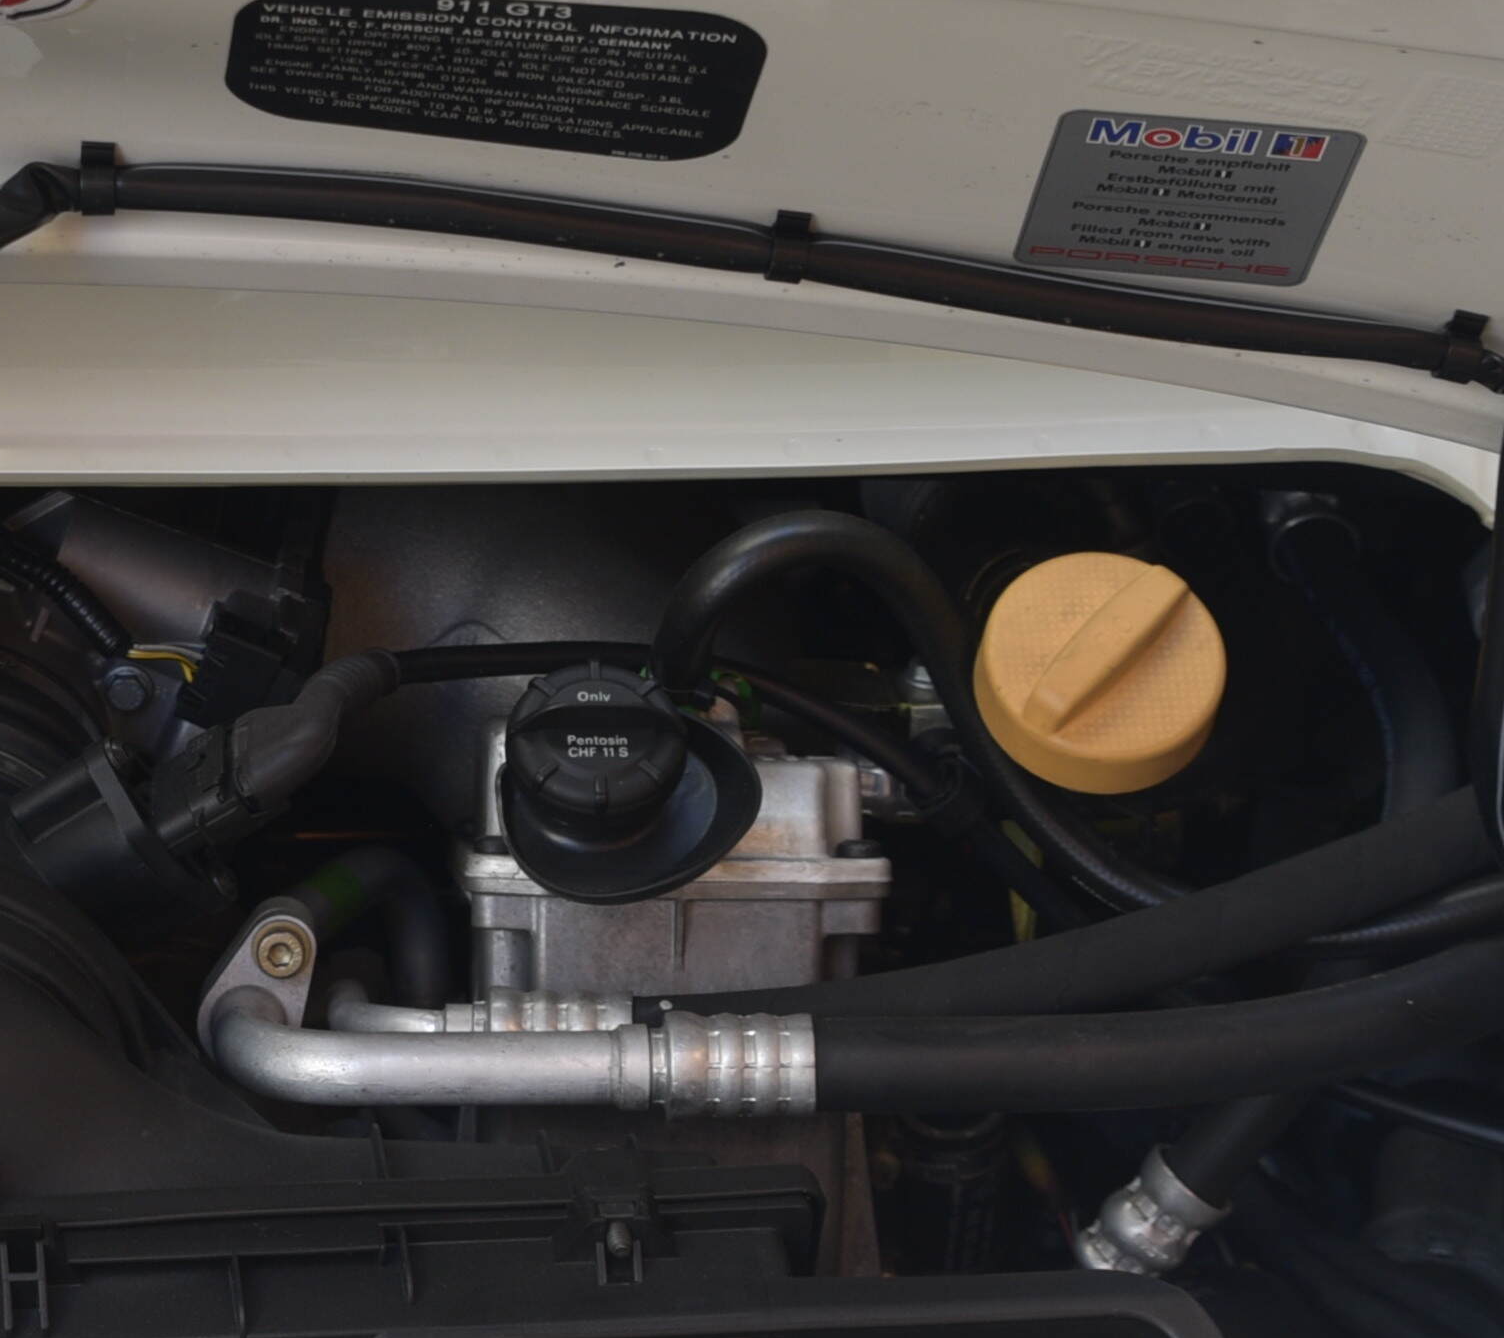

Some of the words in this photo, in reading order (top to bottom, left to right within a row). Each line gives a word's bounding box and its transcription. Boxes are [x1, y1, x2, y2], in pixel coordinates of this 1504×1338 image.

[262, 2, 352, 17] VEHICLE
[361, 8, 465, 24] EMISSION
[474, 16, 580, 32] CONTROL
[588, 23, 739, 43] INFORMATION
[503, 2, 574, 19] GT3
[259, 14, 284, 24] DR.
[291, 16, 323, 26] ING.
[460, 28, 485, 37] AG
[490, 30, 585, 44] STUTTGART
[596, 37, 673, 51] GERMANY
[278, 24, 329, 35] ENGINE
[337, 28, 355, 37] AT
[363, 30, 441, 43] OPERATING
[559, 44, 600, 55] GEAR
[605, 48, 621, 57] IN
[625, 49, 690, 62] NEUTRAL
[254, 31, 285, 42] IDLE
[292, 34, 341, 46] SPEED
[479, 49, 511, 58] IDLE
[516, 51, 576, 64] MIXTURE
[316, 45, 374, 57] SETTING
[495, 59, 514, 68] AT
[520, 61, 551, 72] IDLE
[568, 66, 597, 76] NOT
[603, 68, 695, 84] ADJUSTABLE
[248, 65, 279, 75] SEE
[283, 68, 344, 81] OWNERS
[350, 75, 408, 87] MANUAL
[414, 81, 445, 90] AND
[638, 103, 712, 118] SCHEDULE
[363, 84, 393, 94] FOR
[399, 88, 477, 103] ADDITIONAL
[550, 75, 626, 89] UNLEADED
[555, 85, 606, 97] ENGINE
[247, 82, 277, 92] THIS
[283, 85, 339, 99] VEHICLE
[346, 92, 421, 107] CONFORMS
[427, 100, 446, 110] TO
[520, 112, 615, 129] REGULATIONS
[619, 122, 705, 139] APPLICABLE
[307, 96, 325, 105] TO
[368, 102, 414, 115] MODEL
[421, 108, 460, 120] YEAR
[464, 113, 498, 124] NEW
[502, 118, 550, 131] MOTOR
[1085, 116, 1263, 156] Mobil
[1108, 149, 1189, 164] Porsche
[1193, 156, 1292, 174] empfiehlt
[1156, 164, 1213, 177] Mobil
[1095, 182, 1150, 195] Mobil
[1175, 189, 1278, 206] Motorenöl
[1105, 172, 1238, 192] Erstbefüllung
[1241, 183, 1277, 194] mit
[1070, 201, 1152, 216] Porsche
[1155, 208, 1287, 227] recommends
[1136, 217, 1191, 230] Mobil
[1069, 222, 1123, 235] Filled
[1127, 228, 1174, 239] from
[1178, 233, 1224, 244] new
[1226, 236, 1273, 248] with
[1077, 234, 1132, 247] Mobil
[1155, 242, 1226, 256] engine
[1229, 247, 1255, 257] oil
[1027, 244, 1294, 277] PORSCHE
[567, 735, 628, 746] Pentosin
[568, 747, 598, 758] CHF
[618, 747, 630, 758] S
